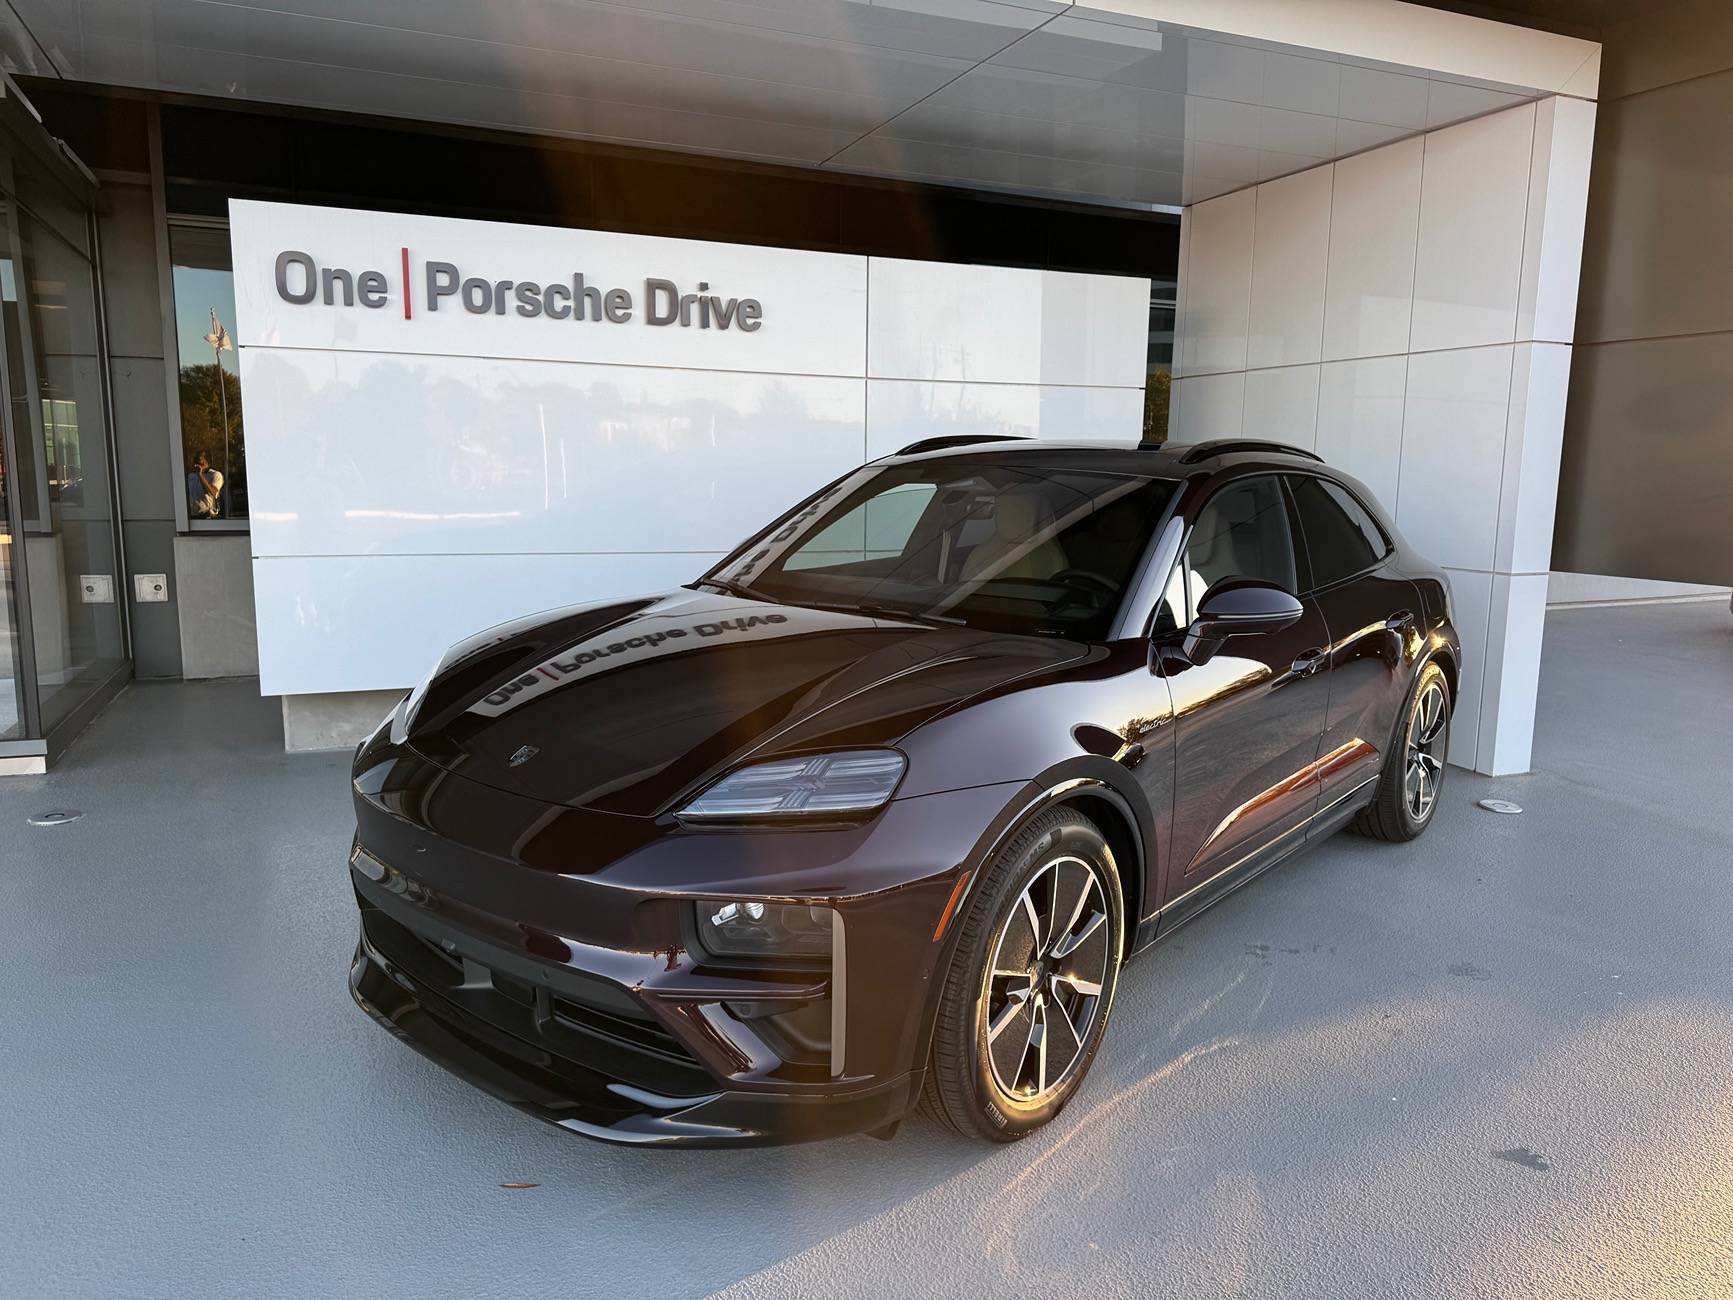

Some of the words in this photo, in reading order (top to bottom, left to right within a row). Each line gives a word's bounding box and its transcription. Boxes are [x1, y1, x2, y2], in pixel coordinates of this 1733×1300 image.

[275, 250, 388, 308] One
[426, 261, 633, 323] Porsche
[645, 277, 763, 332] Drive
[1140, 718, 1173, 733] electric
